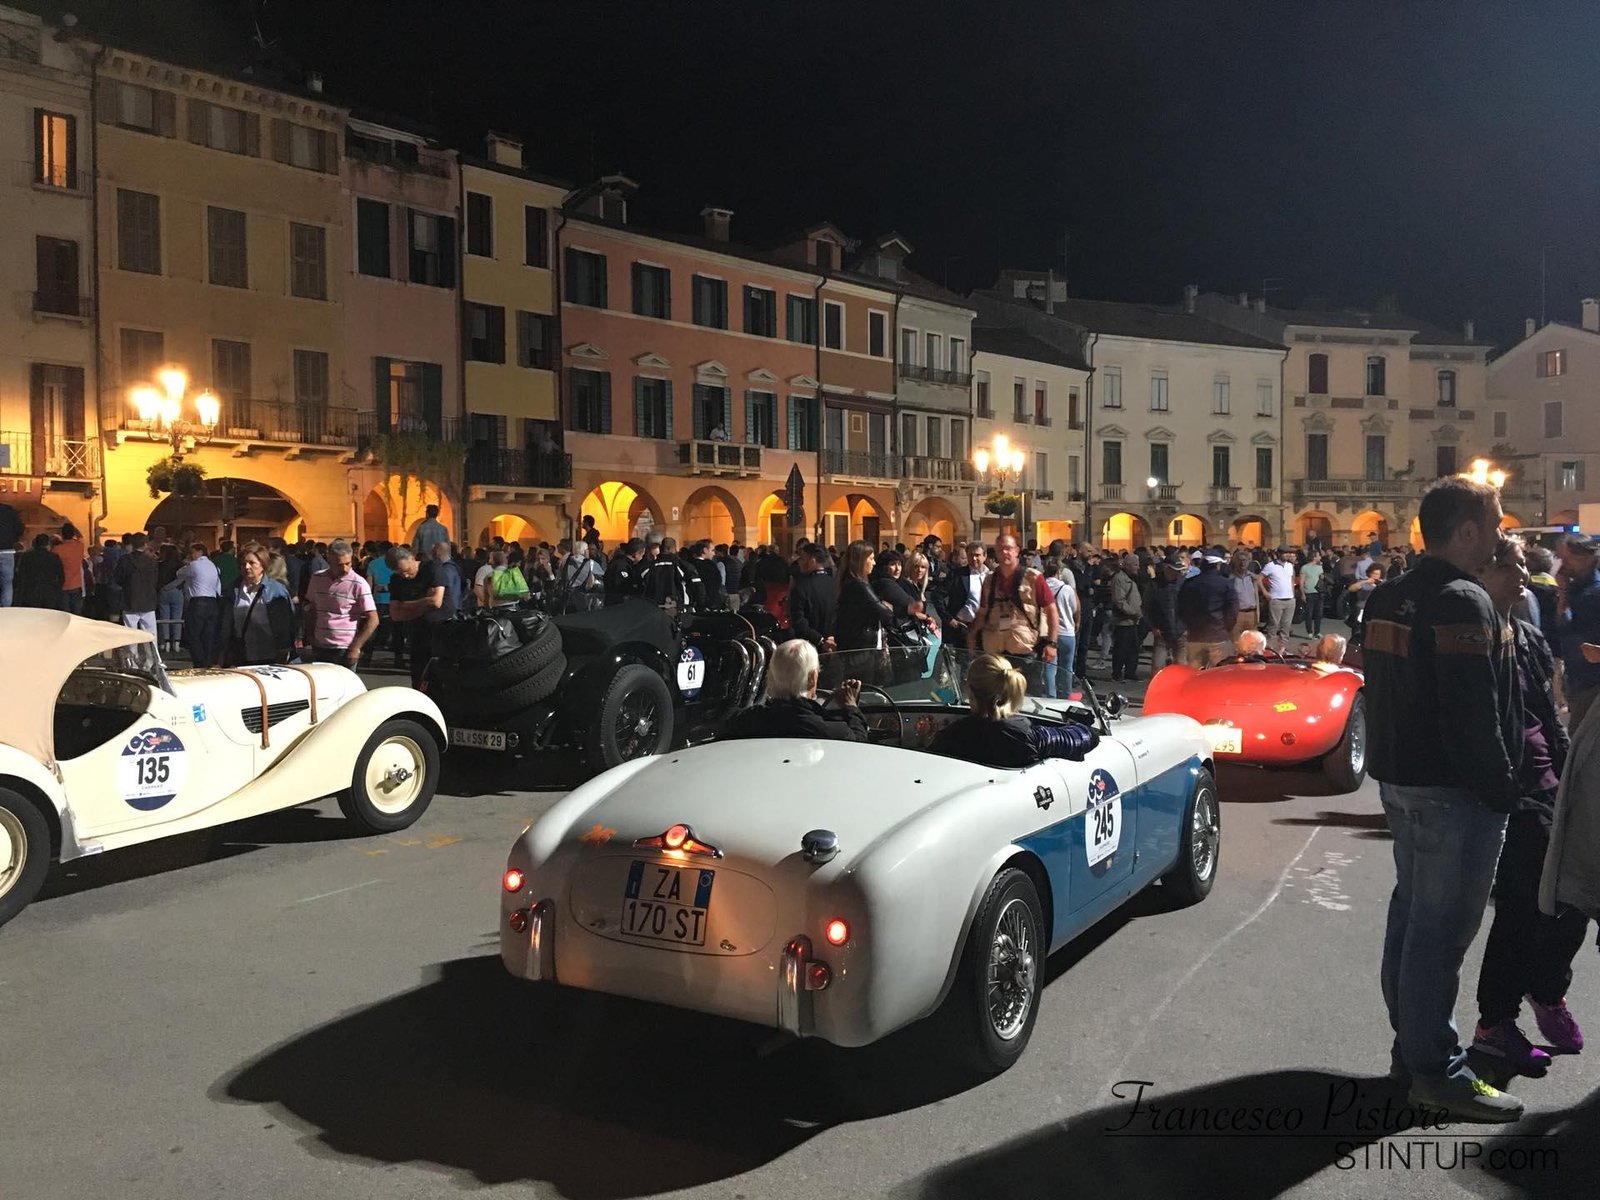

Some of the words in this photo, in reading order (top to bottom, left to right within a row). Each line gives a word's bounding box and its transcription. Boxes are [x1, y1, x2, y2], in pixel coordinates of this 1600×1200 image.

[687, 664, 696, 681] 61
[472, 732, 489, 746] SSK
[490, 734, 502, 747] 29
[136, 755, 170, 785] 135
[1094, 801, 1114, 847] 245
[653, 868, 681, 900] ZA
[629, 901, 667, 935] 170
[674, 908, 705, 941] ST
